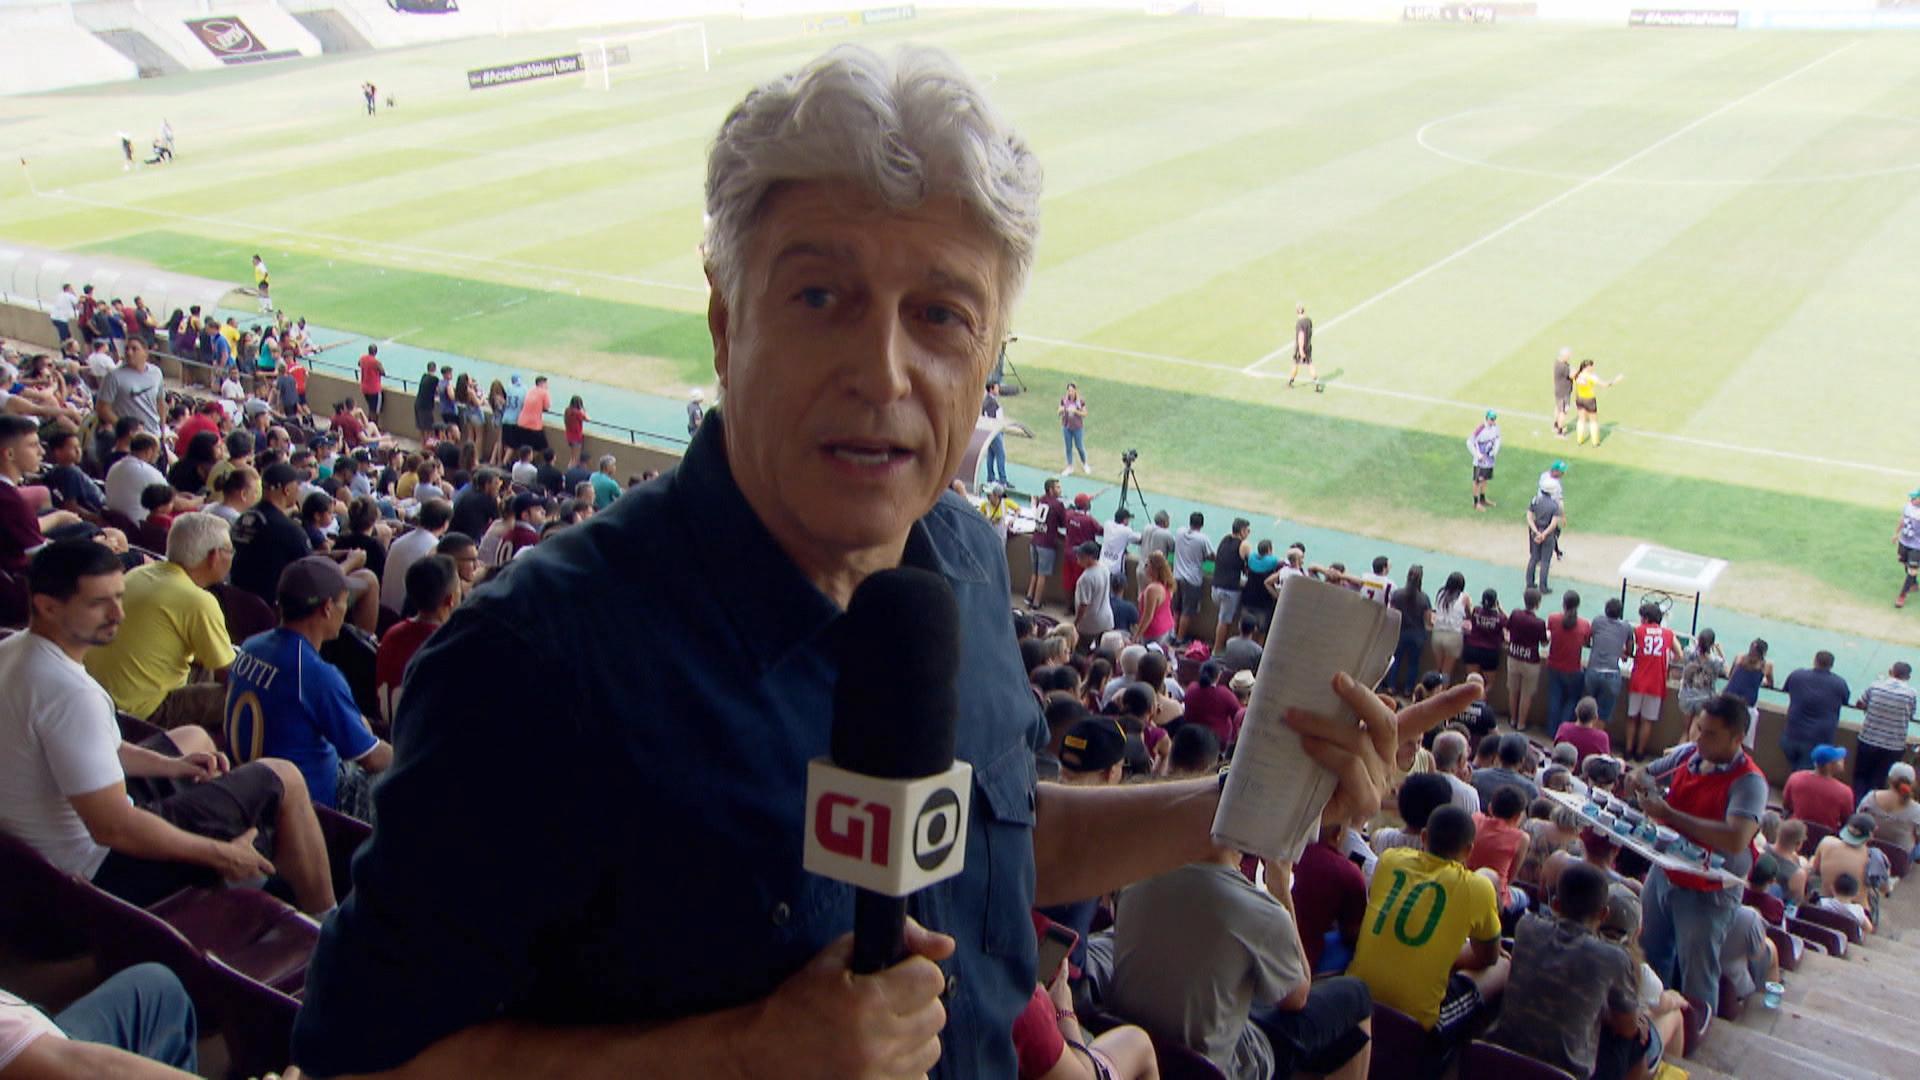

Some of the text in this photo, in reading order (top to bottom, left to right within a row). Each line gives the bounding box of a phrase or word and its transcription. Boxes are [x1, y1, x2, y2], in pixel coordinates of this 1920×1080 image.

[1643, 635, 1664, 656] 32
[814, 791, 892, 868] G1
[1371, 867, 1448, 948] 10
